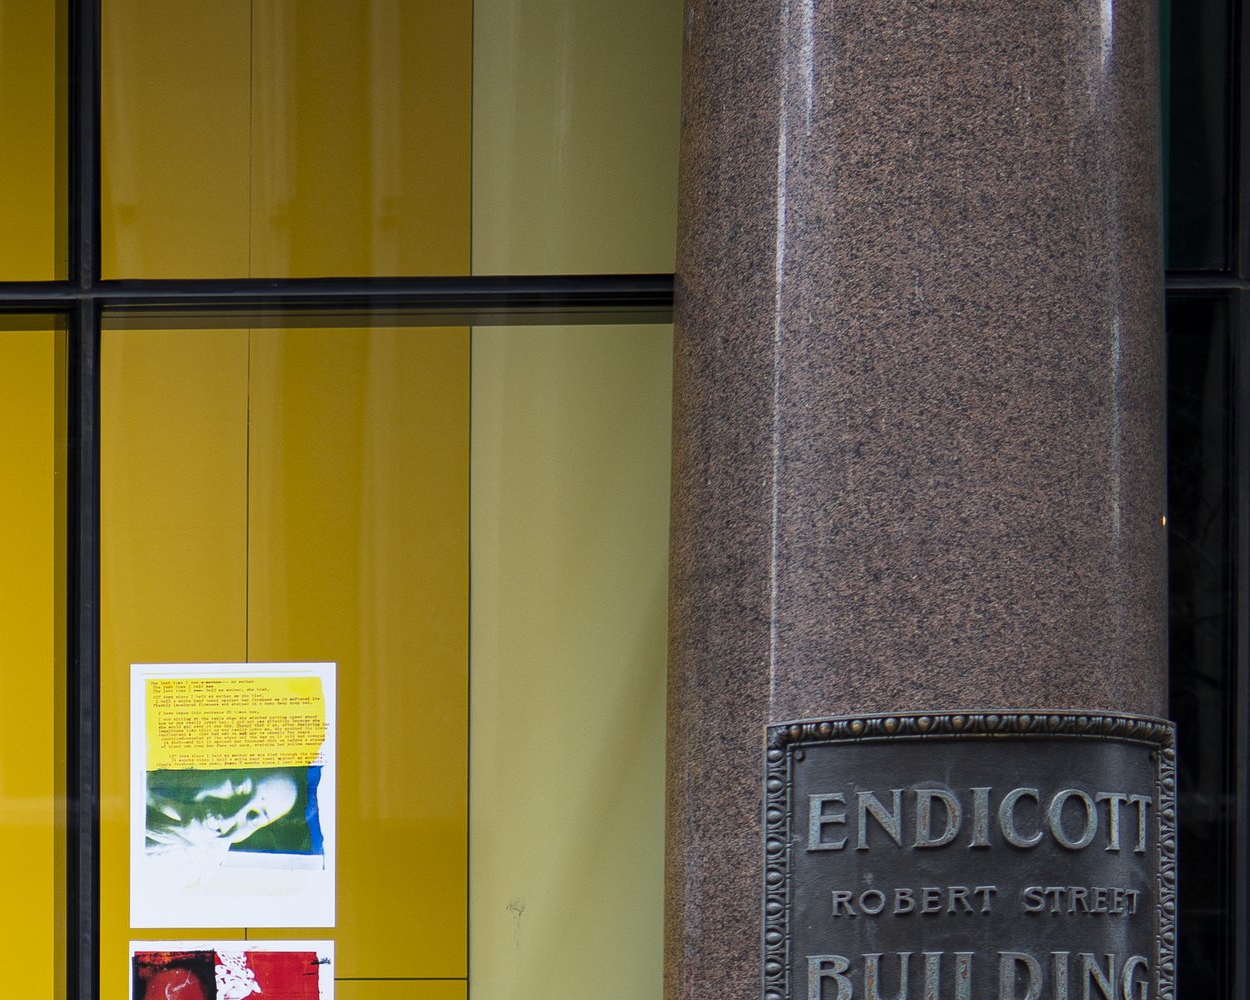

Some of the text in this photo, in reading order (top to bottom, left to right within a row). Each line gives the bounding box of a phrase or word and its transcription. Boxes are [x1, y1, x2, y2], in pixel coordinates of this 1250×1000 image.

[806, 786, 1152, 853] ENDICOTT
[831, 885, 1142, 917] ROBERT STREET
